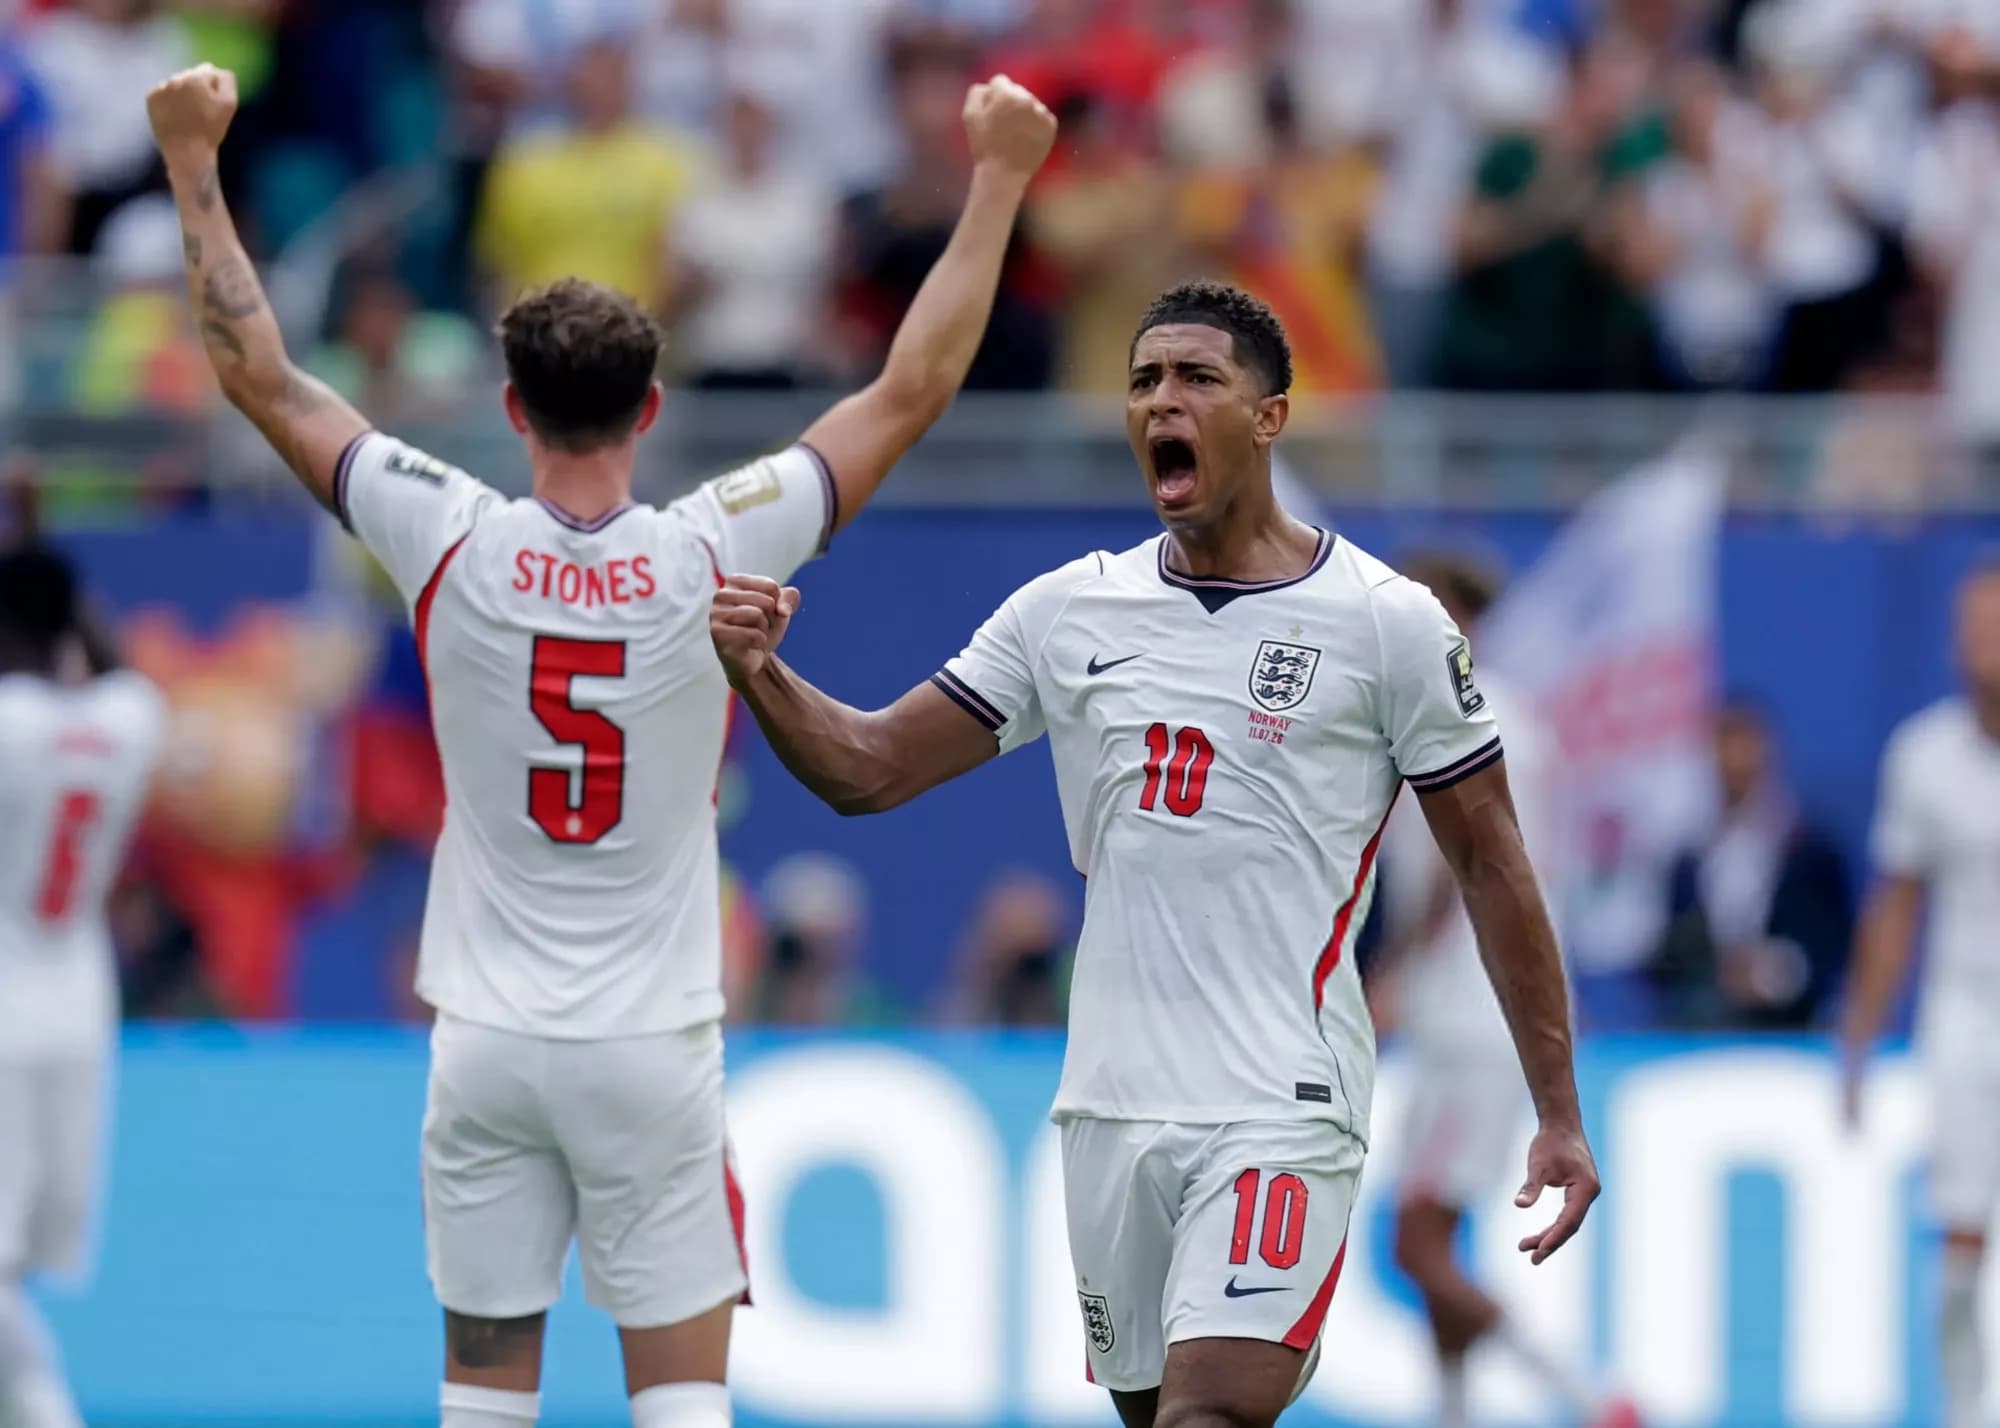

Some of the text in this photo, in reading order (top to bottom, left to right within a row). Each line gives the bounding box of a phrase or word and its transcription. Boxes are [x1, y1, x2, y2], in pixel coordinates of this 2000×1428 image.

[512, 549, 656, 607] STONES
[528, 635, 625, 845] 5
[1248, 711, 1292, 731] NORWAY
[1248, 726, 1284, 745] 11.07.26
[1139, 722, 1214, 817] 10
[1228, 1167, 1309, 1270] 10
